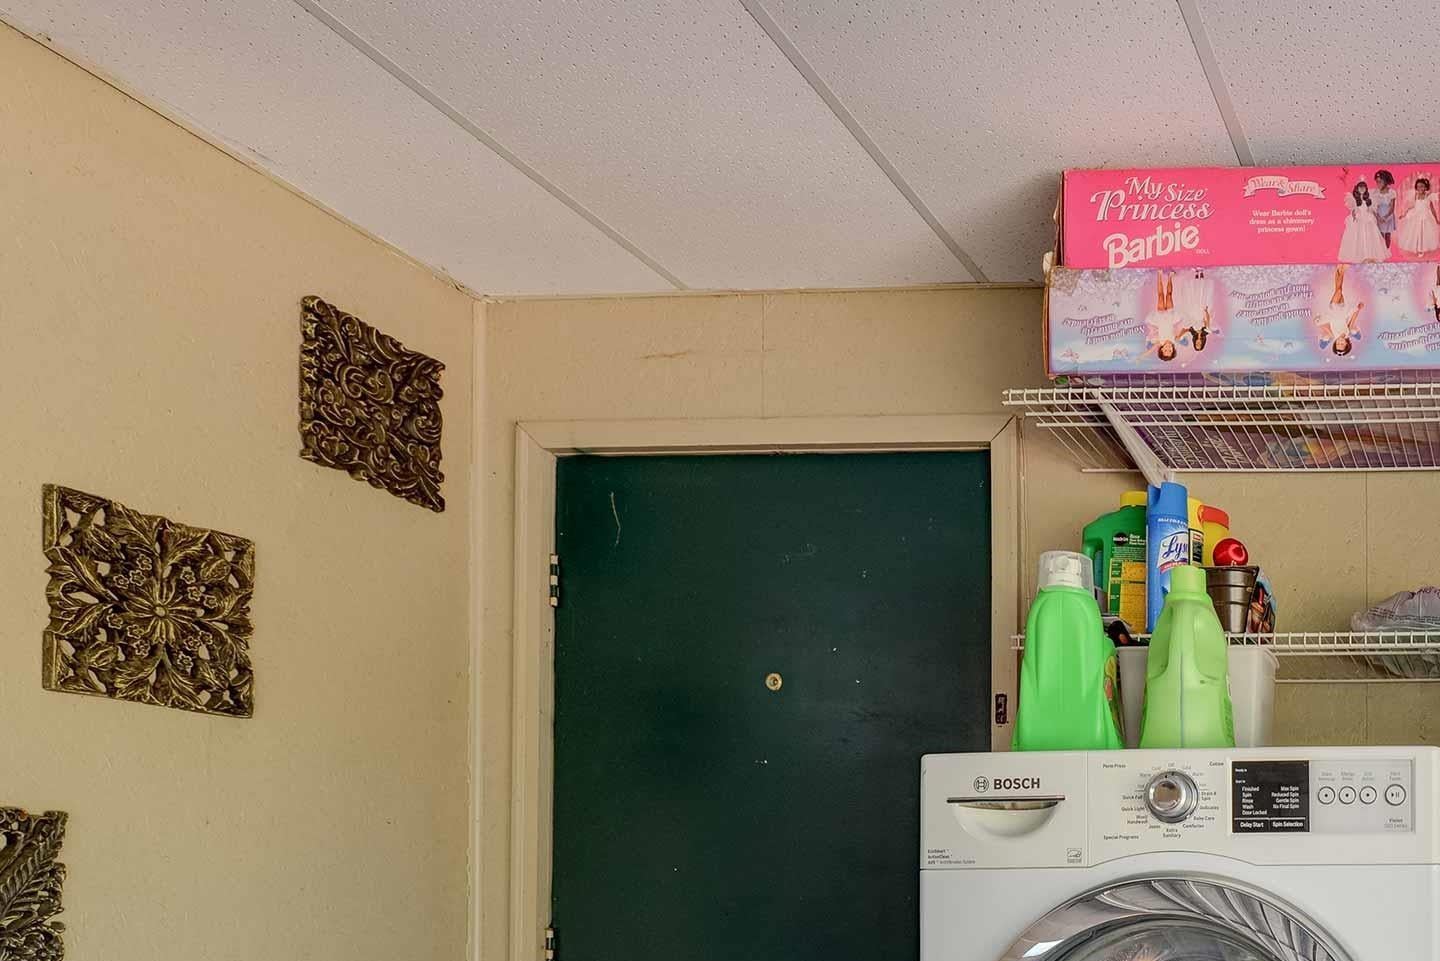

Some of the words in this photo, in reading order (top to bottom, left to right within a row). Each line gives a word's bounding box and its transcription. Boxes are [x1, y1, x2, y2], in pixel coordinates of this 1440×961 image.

[1125, 176, 1166, 200] My
[1165, 183, 1205, 202] Size
[1090, 189, 1216, 221] Princess
[1103, 222, 1200, 269] Barbie
[1162, 536, 1188, 558] Lys
[993, 778, 1041, 790] BOSCH
